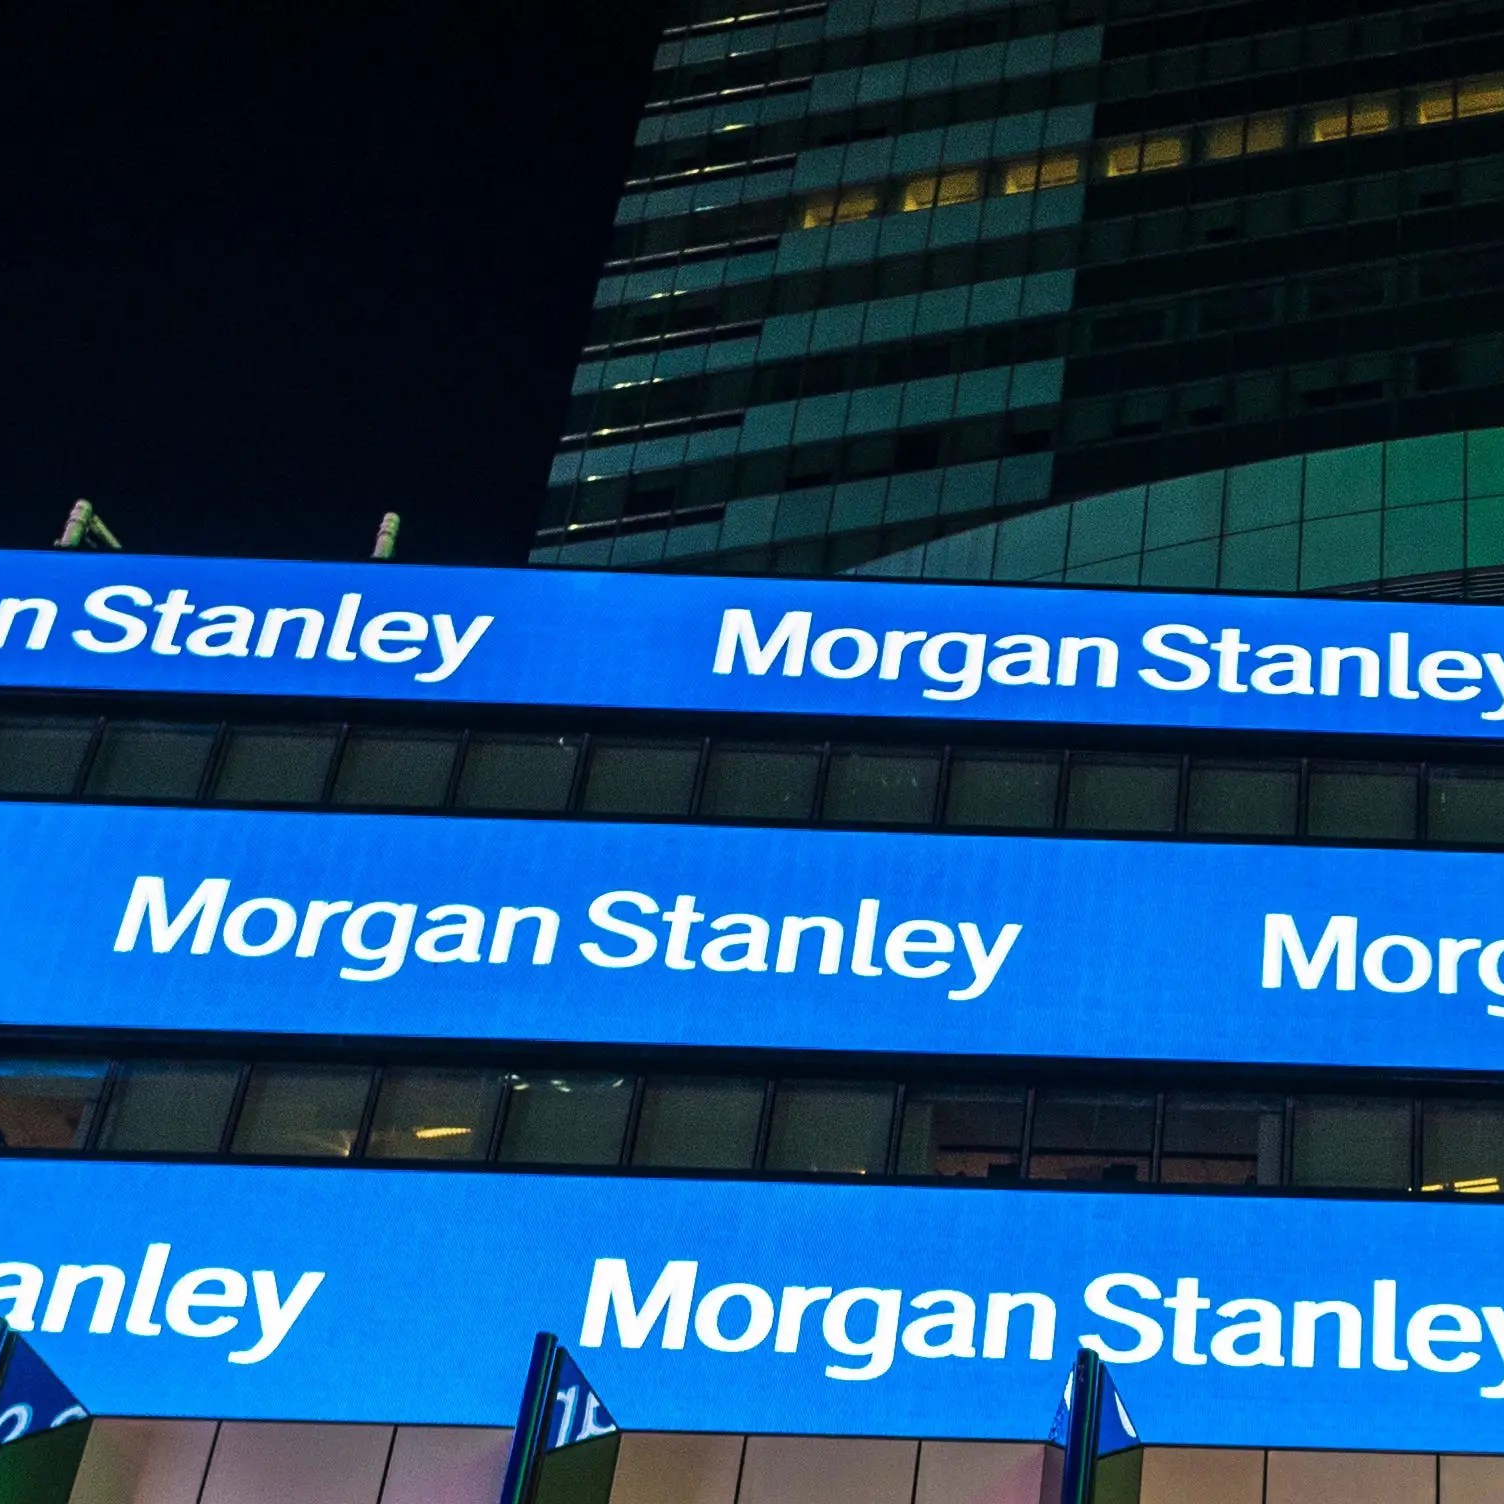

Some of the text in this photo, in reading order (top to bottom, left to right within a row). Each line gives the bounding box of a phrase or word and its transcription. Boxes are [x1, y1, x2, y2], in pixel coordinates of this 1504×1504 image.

[73, 585, 494, 682] Stanley
[713, 609, 1118, 700] Morgan
[114, 876, 1022, 1000] Morgan Stanley
[580, 1258, 1056, 1380] Morgan
